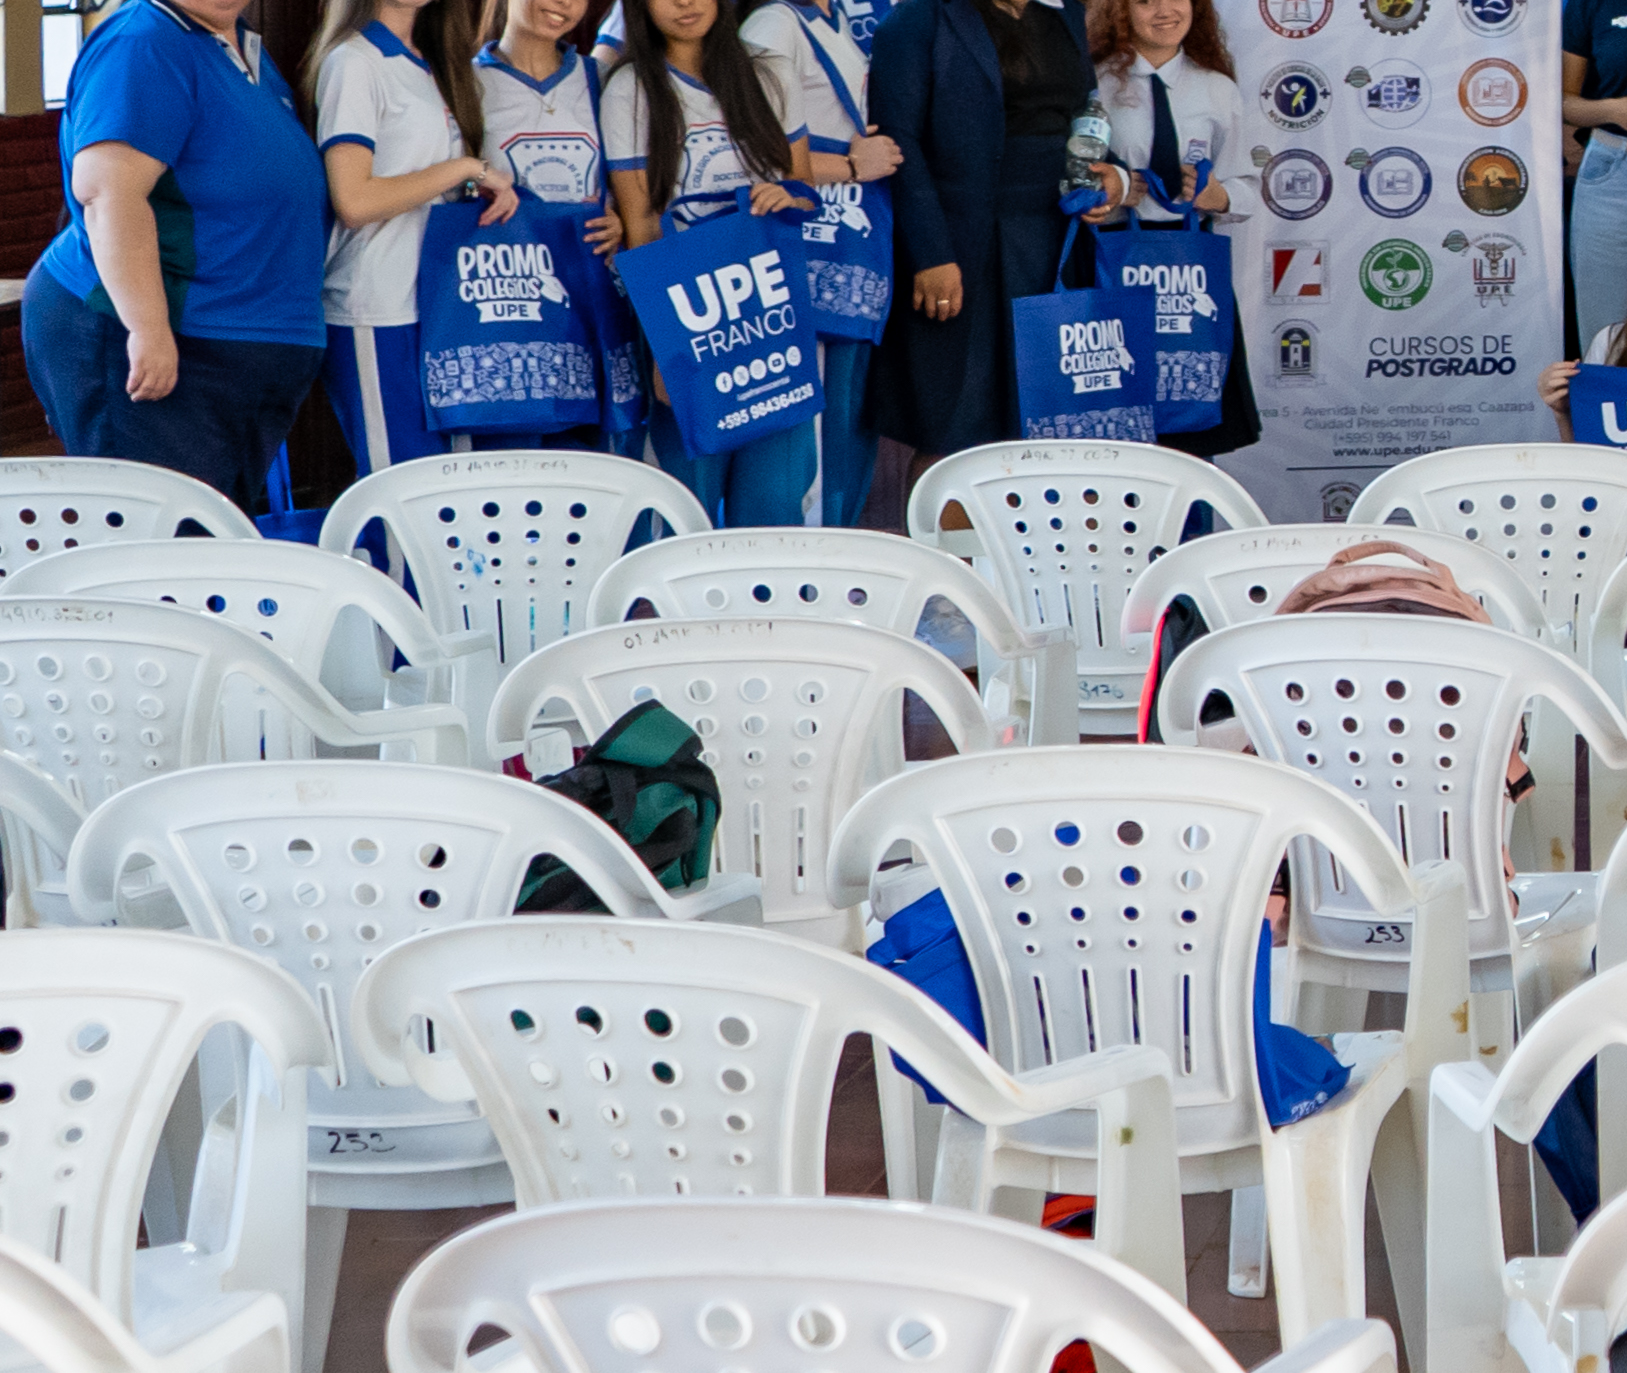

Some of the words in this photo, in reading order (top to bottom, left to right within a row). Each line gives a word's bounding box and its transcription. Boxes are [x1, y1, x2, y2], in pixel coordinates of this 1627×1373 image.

[457, 244, 554, 281] PROMO
[667, 249, 790, 333] UPE
[1476, 284, 1513, 294] UPE
[493, 303, 530, 318] UPE
[1382, 297, 1412, 308] UPE
[1159, 318, 1179, 331] PE
[690, 305, 797, 362] FRANCO
[1059, 318, 1124, 354] PROMO
[1369, 336, 1474, 356] CURSOS
[1482, 335, 1513, 354] DE
[1366, 356, 1517, 378] POSTGRADO
[1083, 374, 1111, 388] UPE
[1303, 404, 1357, 417] Avenida
[1303, 418, 1352, 430] Ciudad
[1357, 416, 1429, 428] Presidente
[1432, 415, 1480, 427] Franco
[1365, 924, 1406, 944] 253
